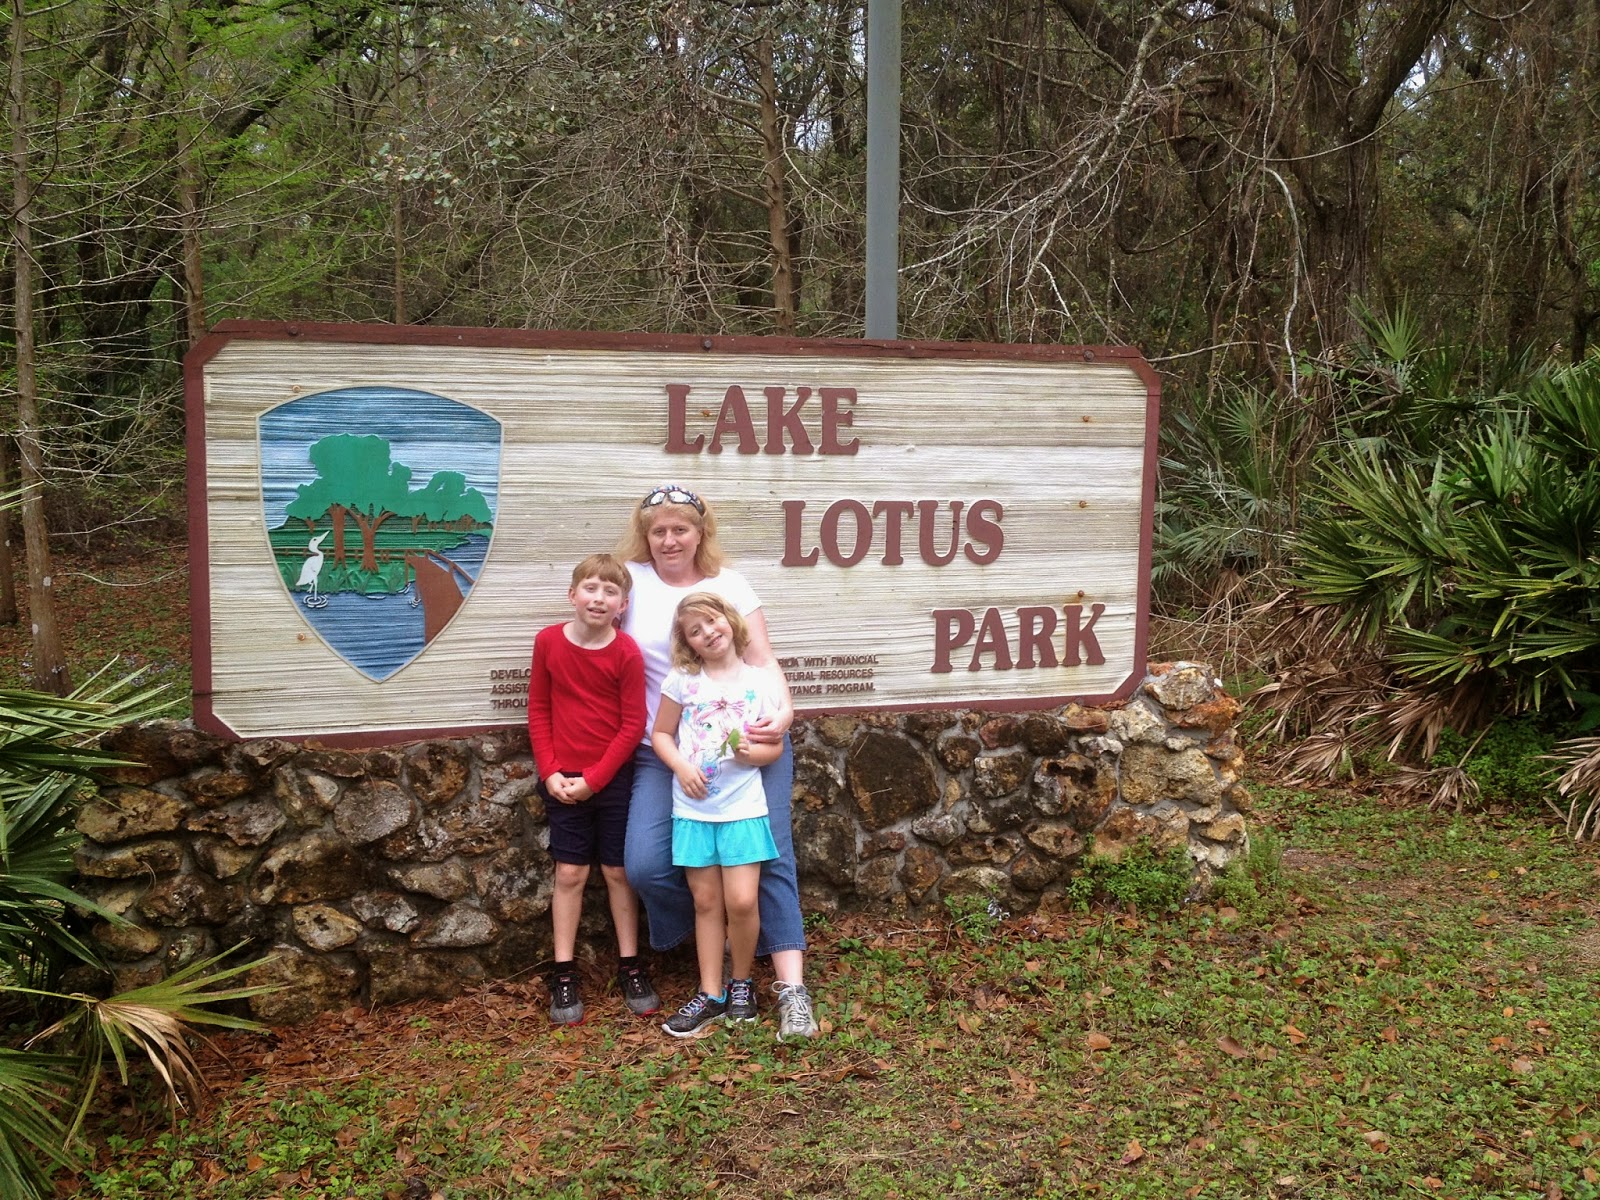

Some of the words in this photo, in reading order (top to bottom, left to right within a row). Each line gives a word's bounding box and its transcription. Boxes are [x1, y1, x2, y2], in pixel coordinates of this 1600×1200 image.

[665, 384, 860, 455] LAKE
[781, 498, 1005, 567] LOTUS
[931, 603, 1106, 673] PARK
[490, 668, 531, 680] DEVELO
[804, 657, 827, 667] WITH
[831, 655, 879, 666] FINANCIAL
[490, 683, 530, 694] ASSIST
[820, 669, 874, 680] RESOURCES
[490, 698, 528, 709] THROU
[789, 685, 822, 695] TANCE
[826, 682, 876, 693] PROGRAM.
